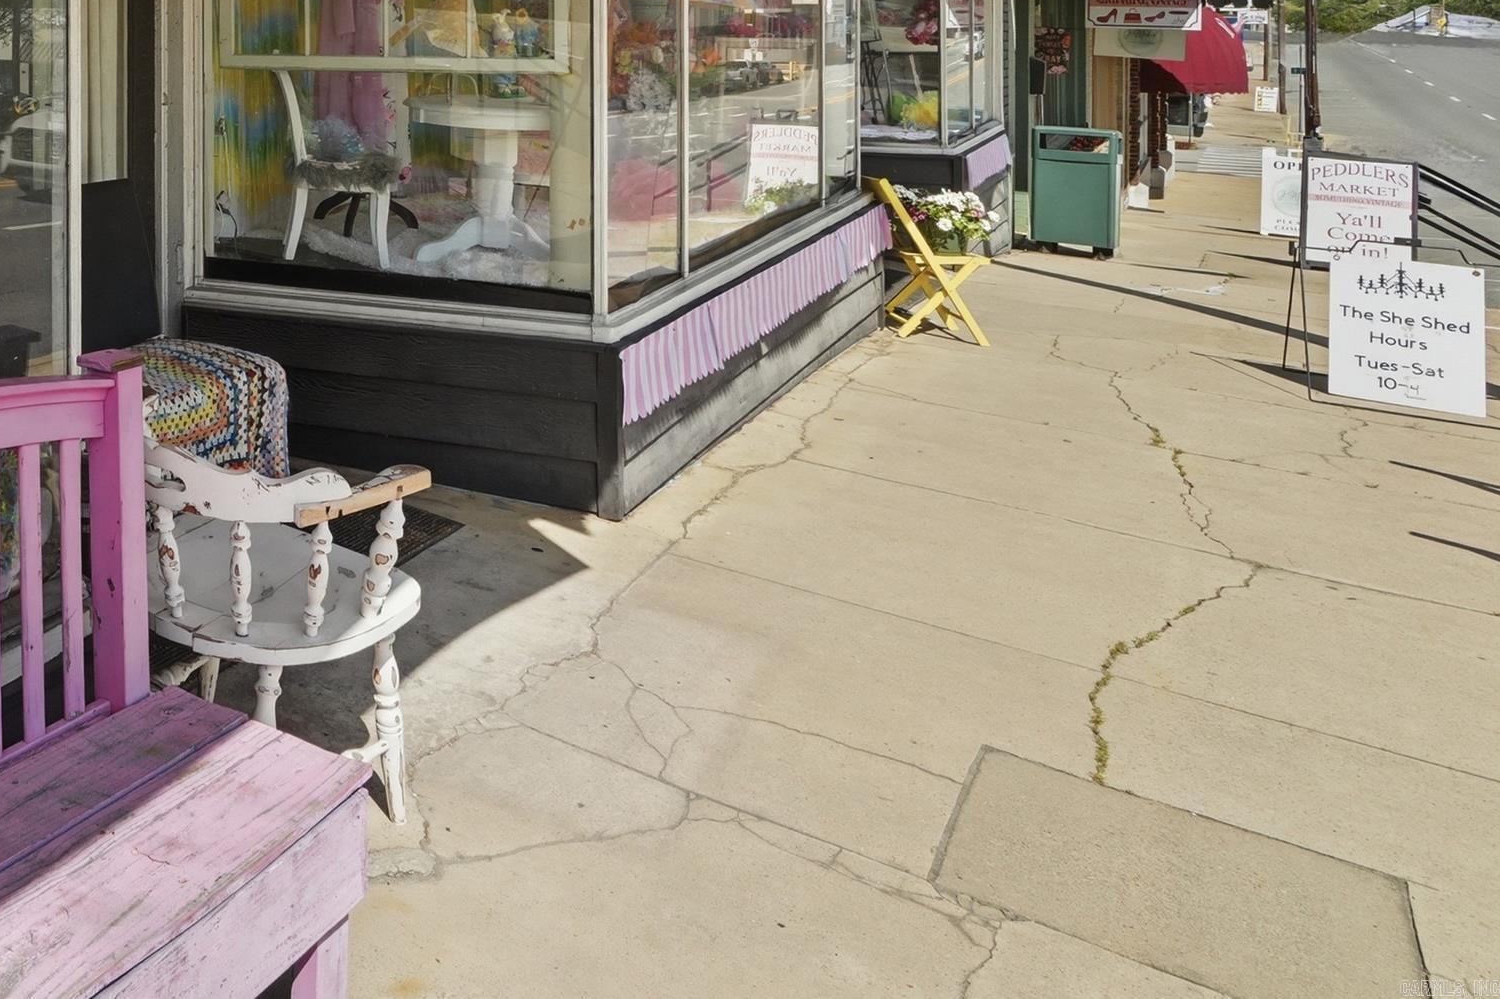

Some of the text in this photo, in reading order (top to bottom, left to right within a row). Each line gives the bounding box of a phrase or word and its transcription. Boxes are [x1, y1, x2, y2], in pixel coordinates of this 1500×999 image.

[1311, 163, 1409, 189] PEDDLERS
[1319, 182, 1400, 198] MARKET
[1336, 212, 1382, 228] Ya'll
[1327, 226, 1391, 242] Come
[1362, 244, 1388, 259] in!
[1339, 304, 1470, 334] The She Shed
[1369, 331, 1428, 351] Hours
